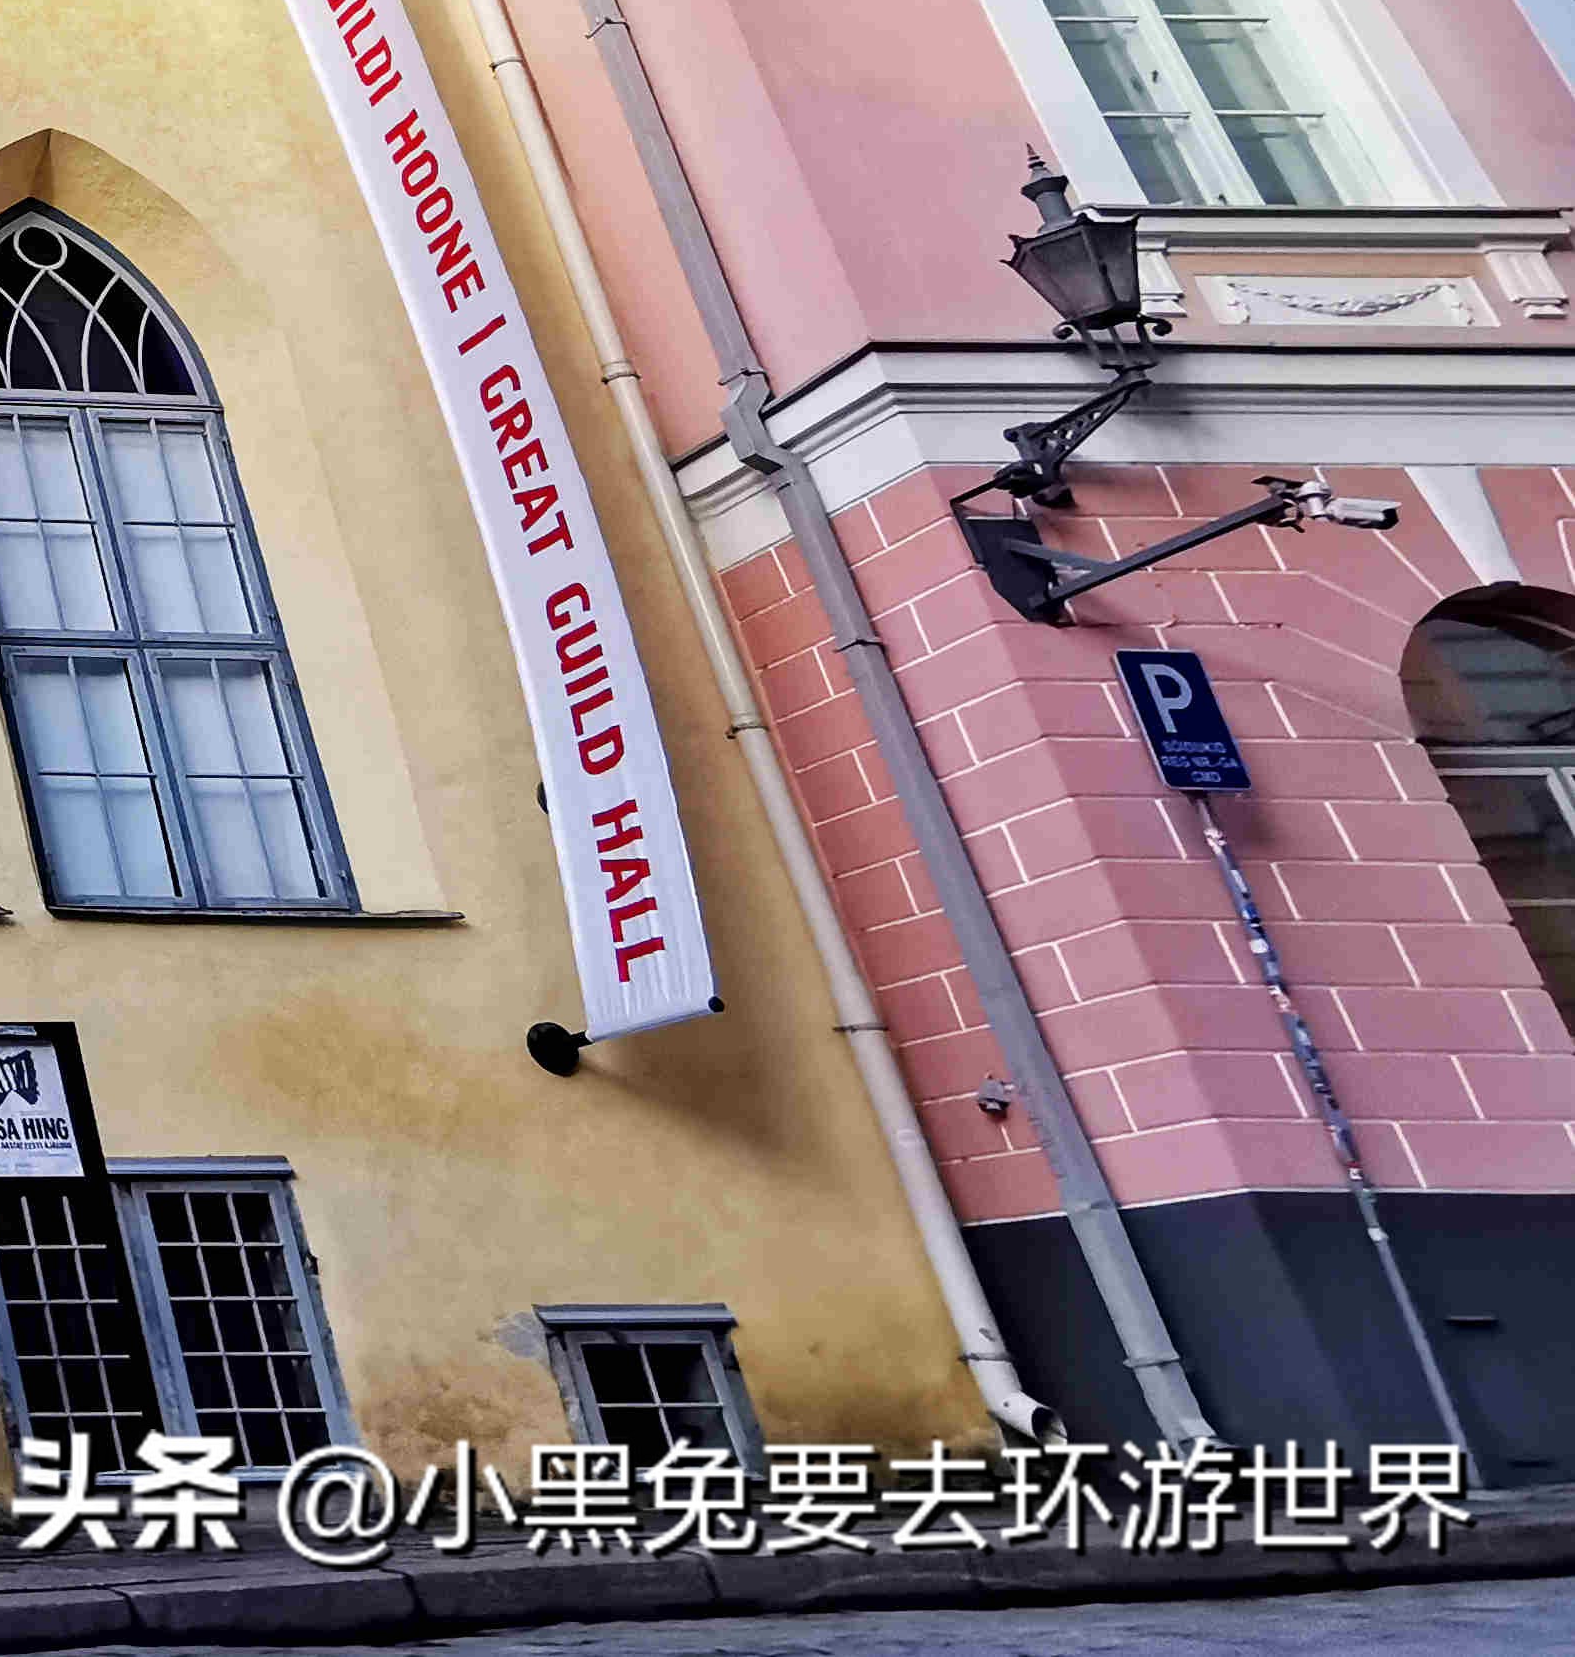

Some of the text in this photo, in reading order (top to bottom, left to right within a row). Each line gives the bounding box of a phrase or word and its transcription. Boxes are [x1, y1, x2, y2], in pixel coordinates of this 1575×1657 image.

[383, 109, 485, 313] HOONE
[480, 364, 573, 555] GREAT
[546, 582, 625, 776] GUILD
[593, 800, 665, 984] HALL
[1140, 663, 1193, 733] P
[20, 1117, 70, 1141] HING
